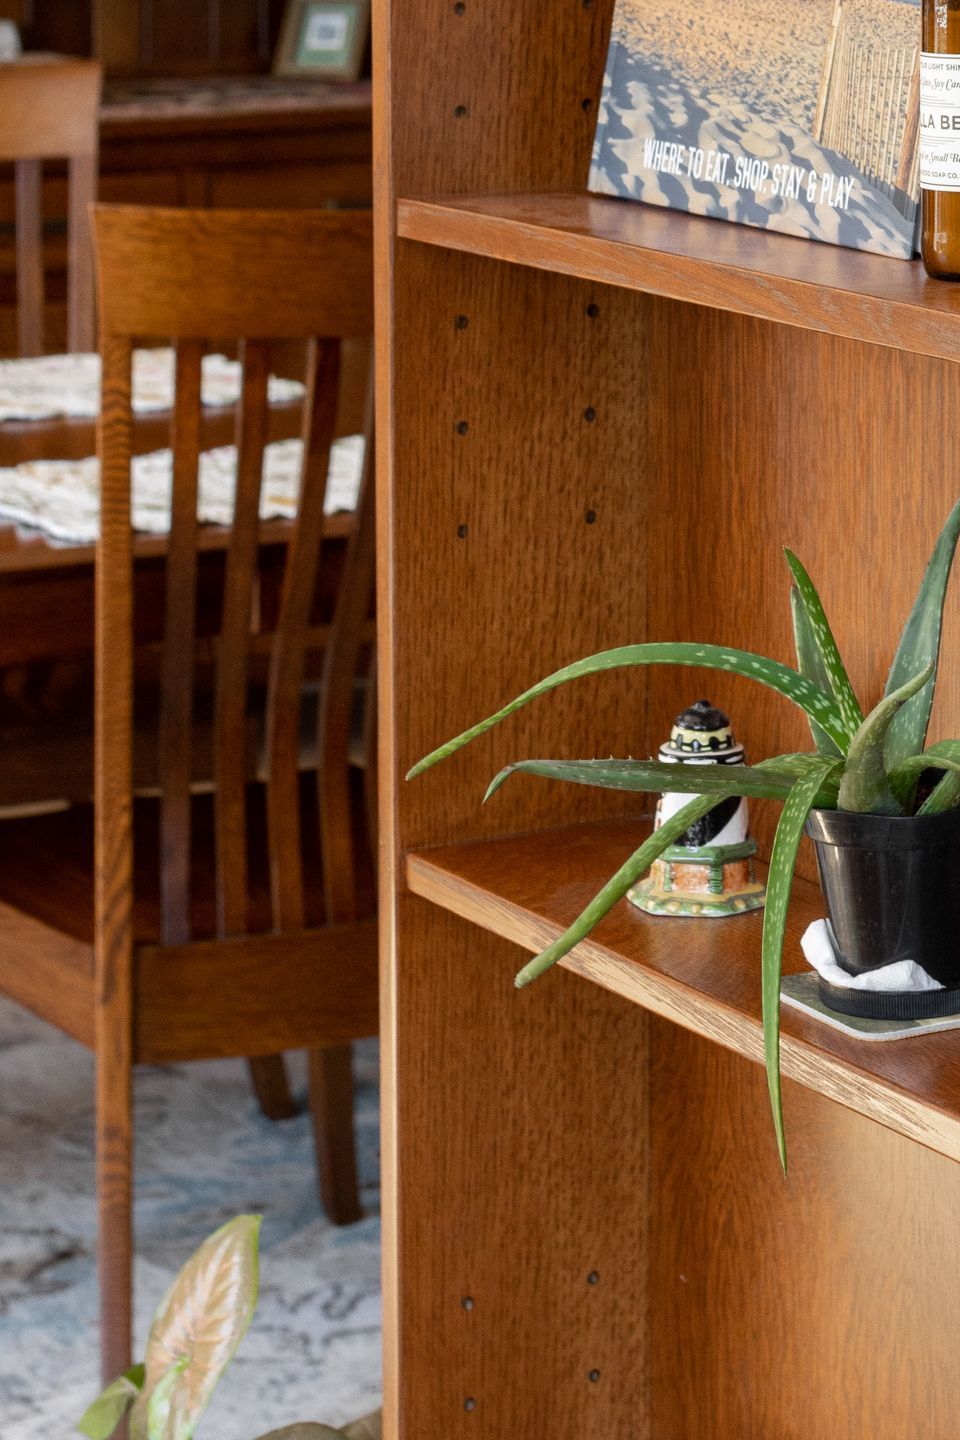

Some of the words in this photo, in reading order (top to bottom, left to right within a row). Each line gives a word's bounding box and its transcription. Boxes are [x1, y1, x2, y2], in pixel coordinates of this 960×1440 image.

[643, 138, 687, 176] WHERE
[687, 146, 704, 179] TO
[771, 163, 806, 200] STAY
[806, 170, 818, 203] &
[820, 173, 855, 210] PLAY
[928, 152, 949, 164] Small
